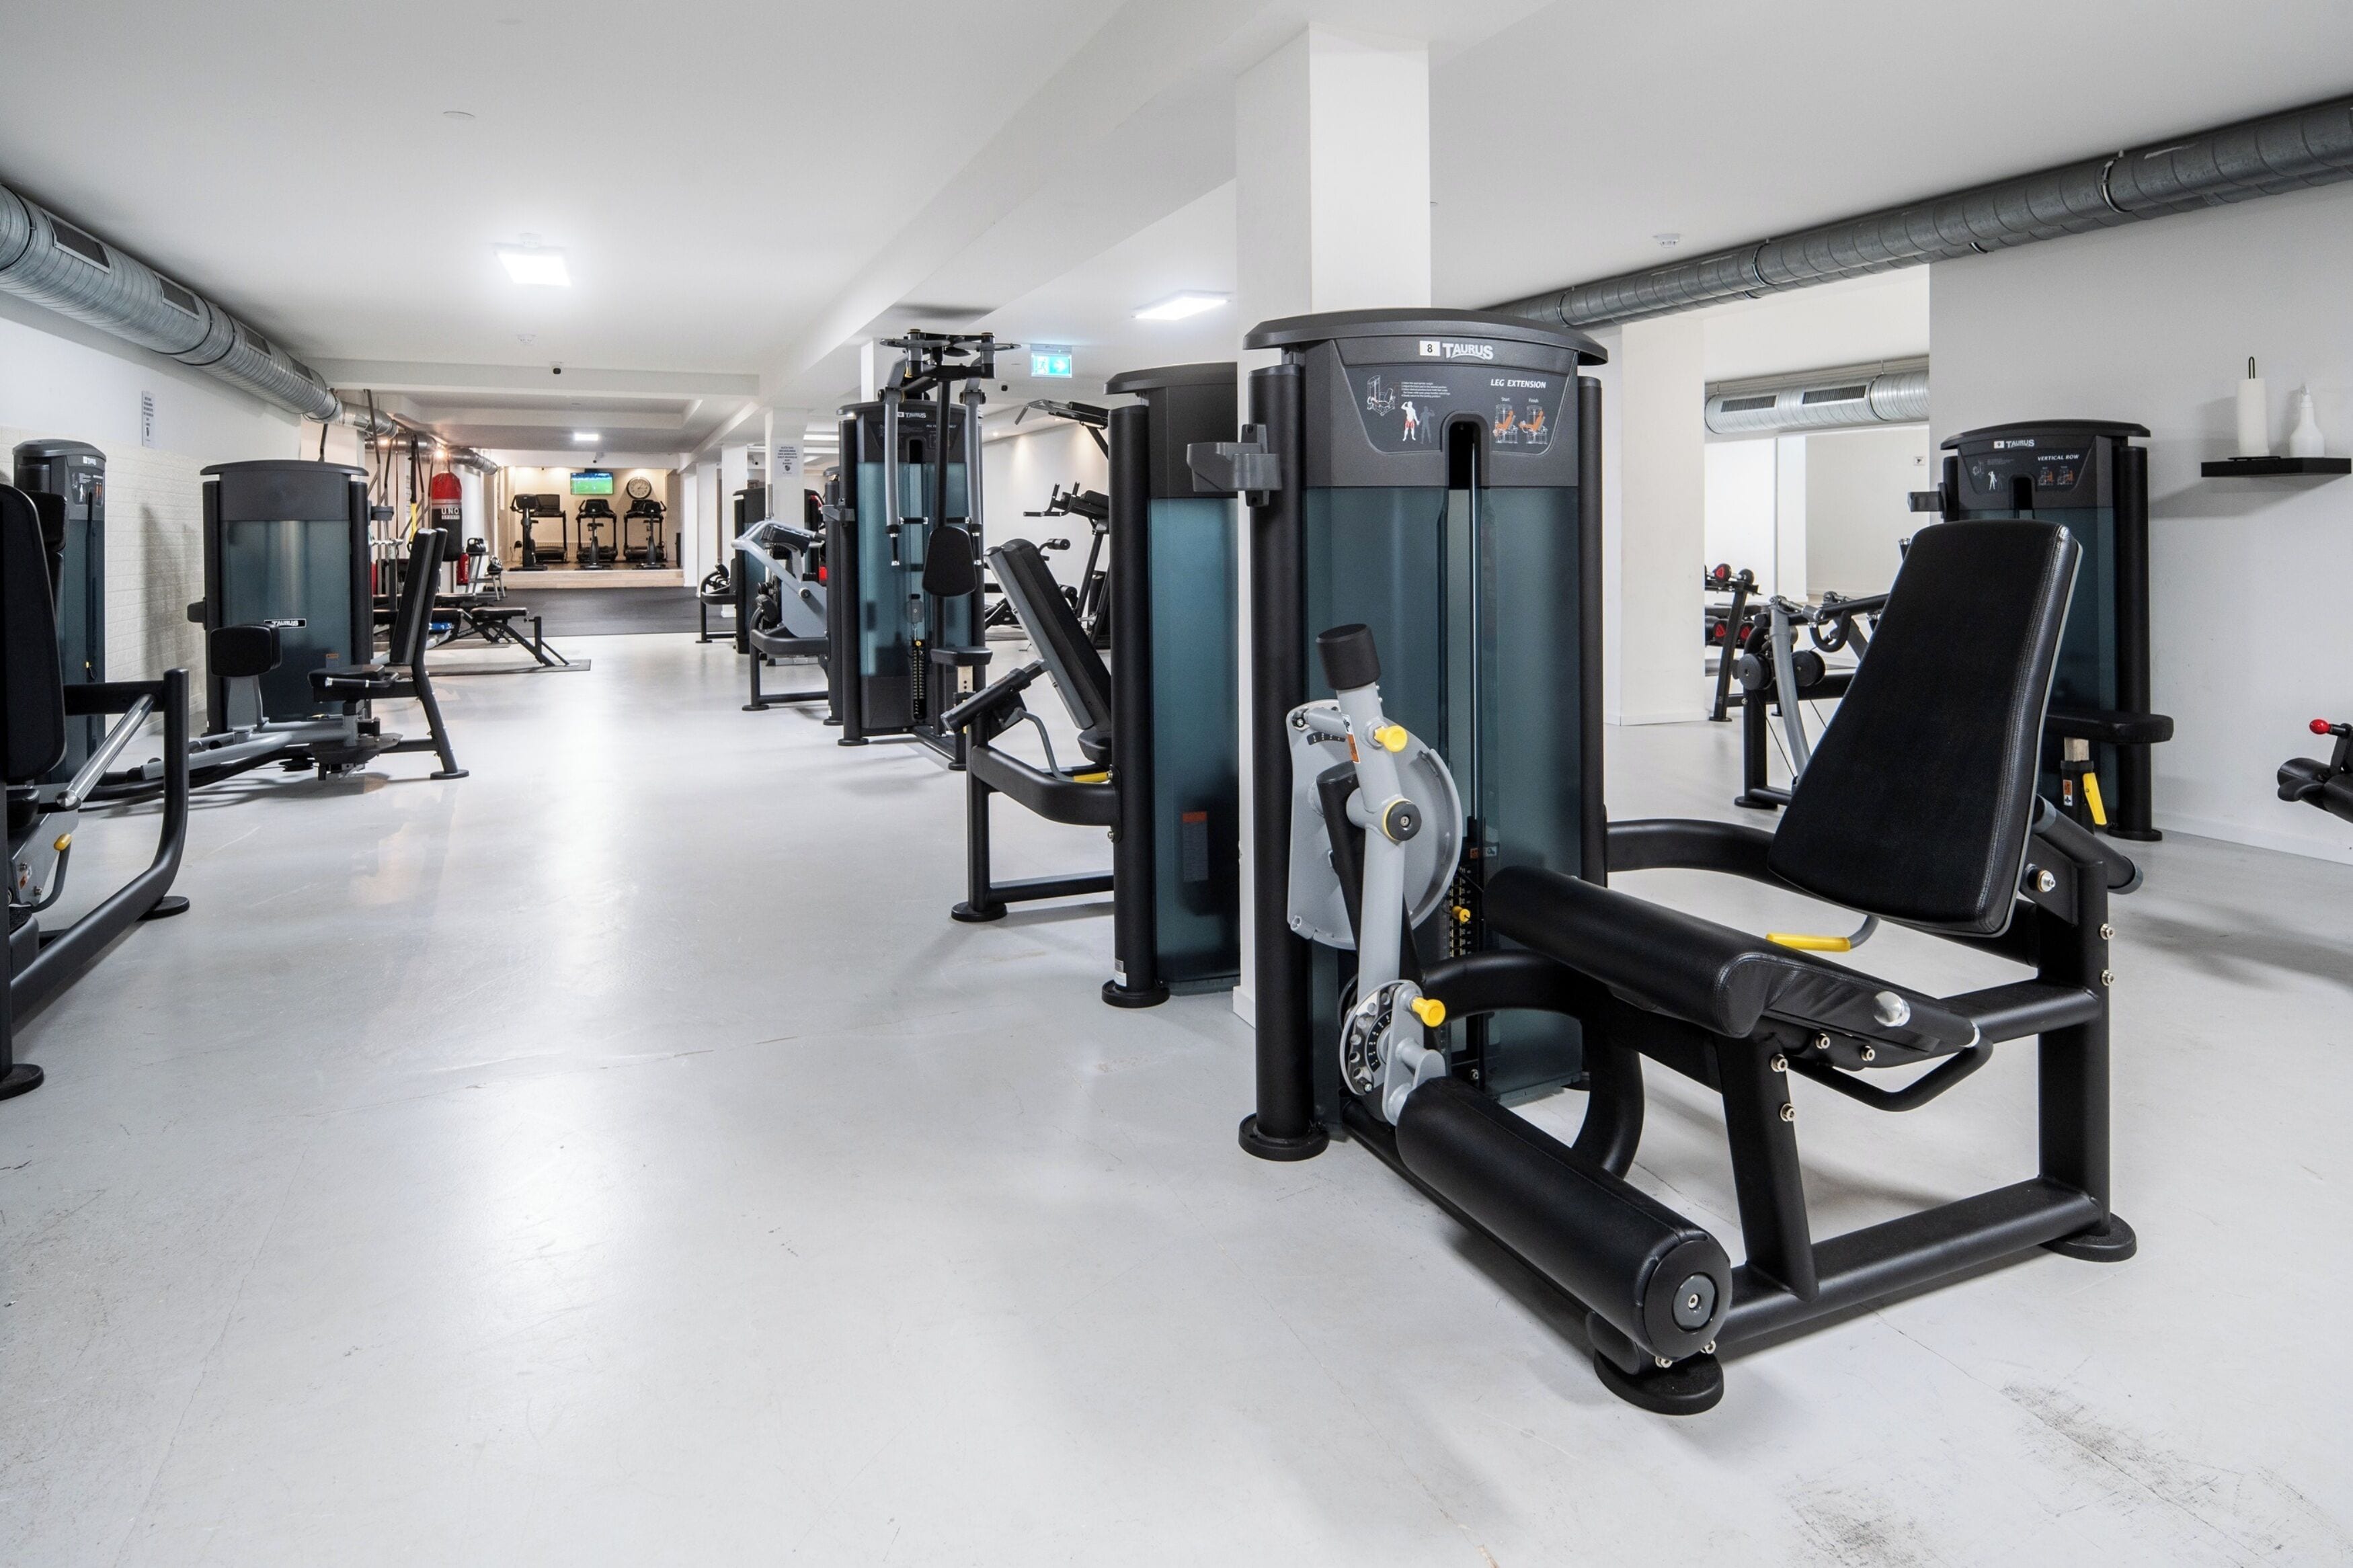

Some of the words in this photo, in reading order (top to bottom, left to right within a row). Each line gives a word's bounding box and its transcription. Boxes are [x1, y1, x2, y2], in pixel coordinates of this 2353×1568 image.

[1427, 343, 1433, 353] 8
[1442, 343, 1494, 360] TAURUS
[1490, 378, 1505, 386] LEG
[1507, 380, 1546, 388] EXTENSION
[2005, 439, 2035, 448] TAURUS
